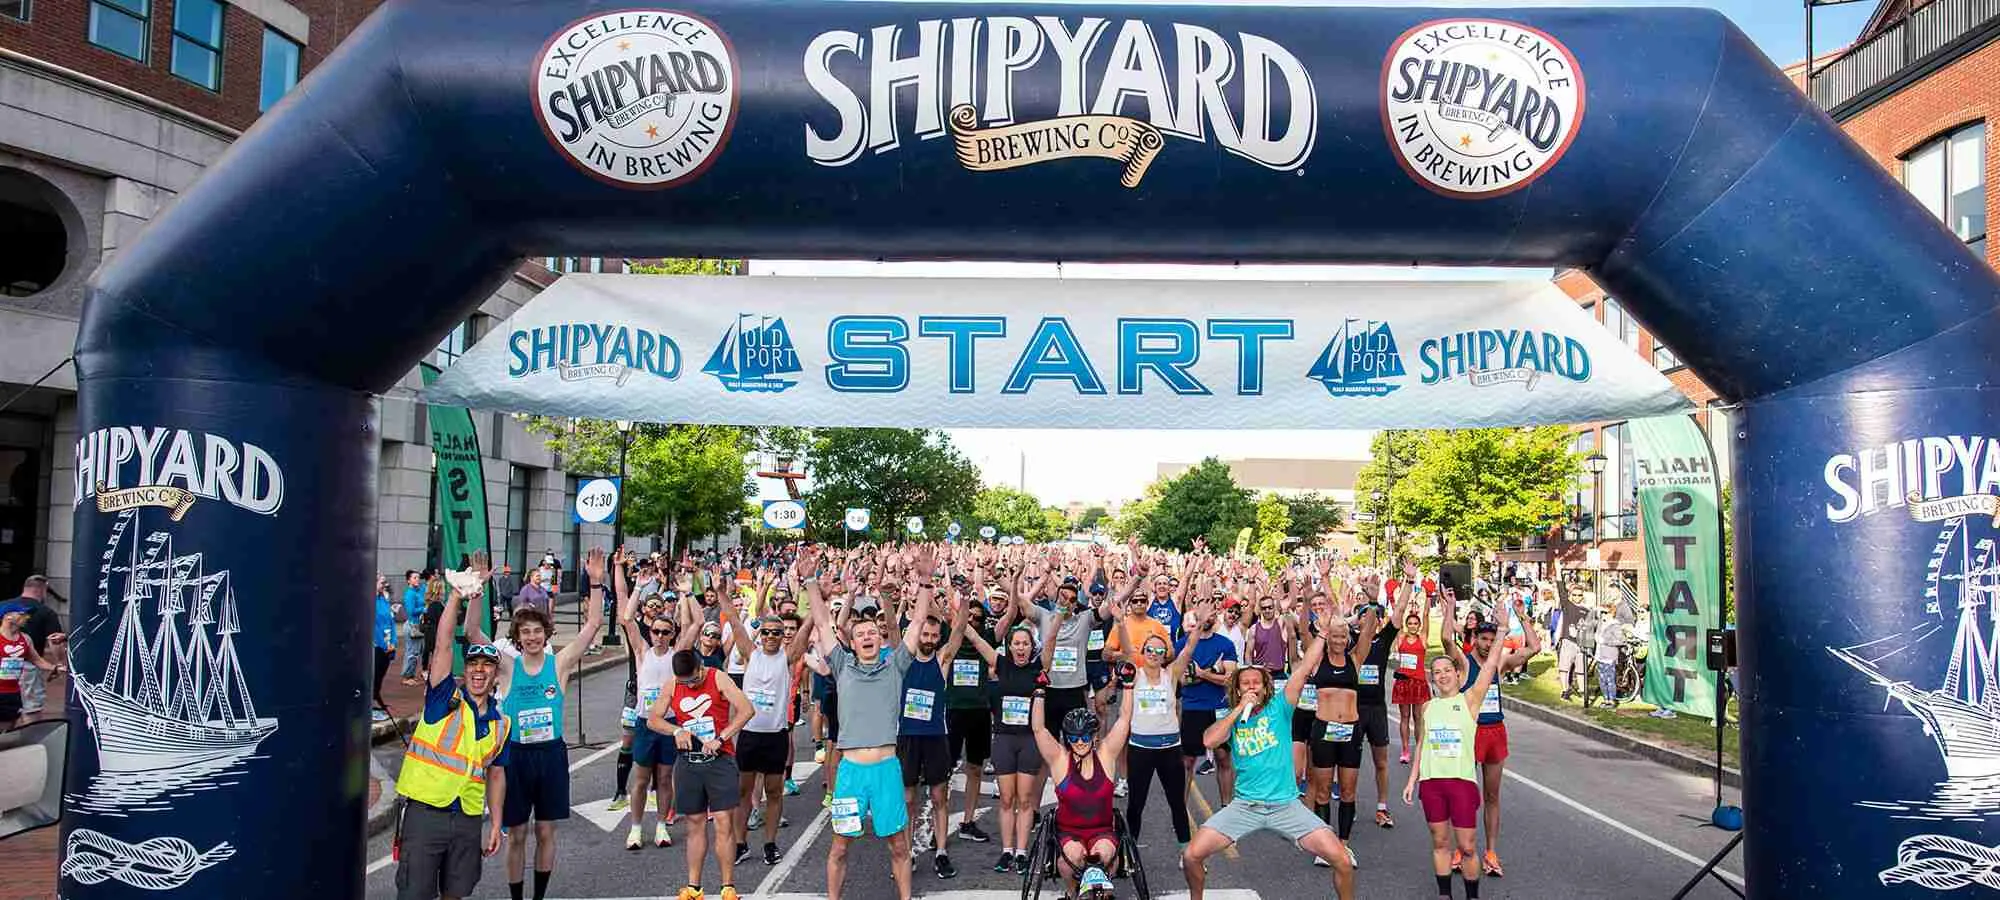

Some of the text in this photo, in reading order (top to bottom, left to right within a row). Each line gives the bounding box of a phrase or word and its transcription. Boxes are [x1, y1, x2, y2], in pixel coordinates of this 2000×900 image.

[546, 15, 706, 80] EXCELLENCE
[1414, 24, 1570, 90] EXCELLENCE
[548, 49, 728, 144] SHIPYARD
[614, 98, 652, 126] BREWING
[804, 16, 1318, 172] SHIPYARD
[1391, 56, 1562, 153] SHIPYARD
[587, 101, 723, 177] IN BREWING
[976, 123, 1089, 164] BREWING
[1398, 113, 1533, 186] IN BREWING
[508, 322, 684, 382] SHIPYARD
[745, 327, 784, 347] OLD
[745, 347, 796, 368] PORT
[825, 315, 1294, 395] START
[1350, 352, 1399, 373] PORT
[1351, 331, 1389, 352] OLD
[1419, 328, 1592, 384] SHIPYARD
[567, 365, 607, 379] BREWING
[1477, 369, 1516, 385] BREWING
[73, 425, 285, 516] HIPYARD
[103, 488, 154, 509] BREWING
[1823, 435, 2000, 523] SHIPYA
[774, 509, 796, 520] 1:30
[1921, 496, 1979, 519] BREWING
